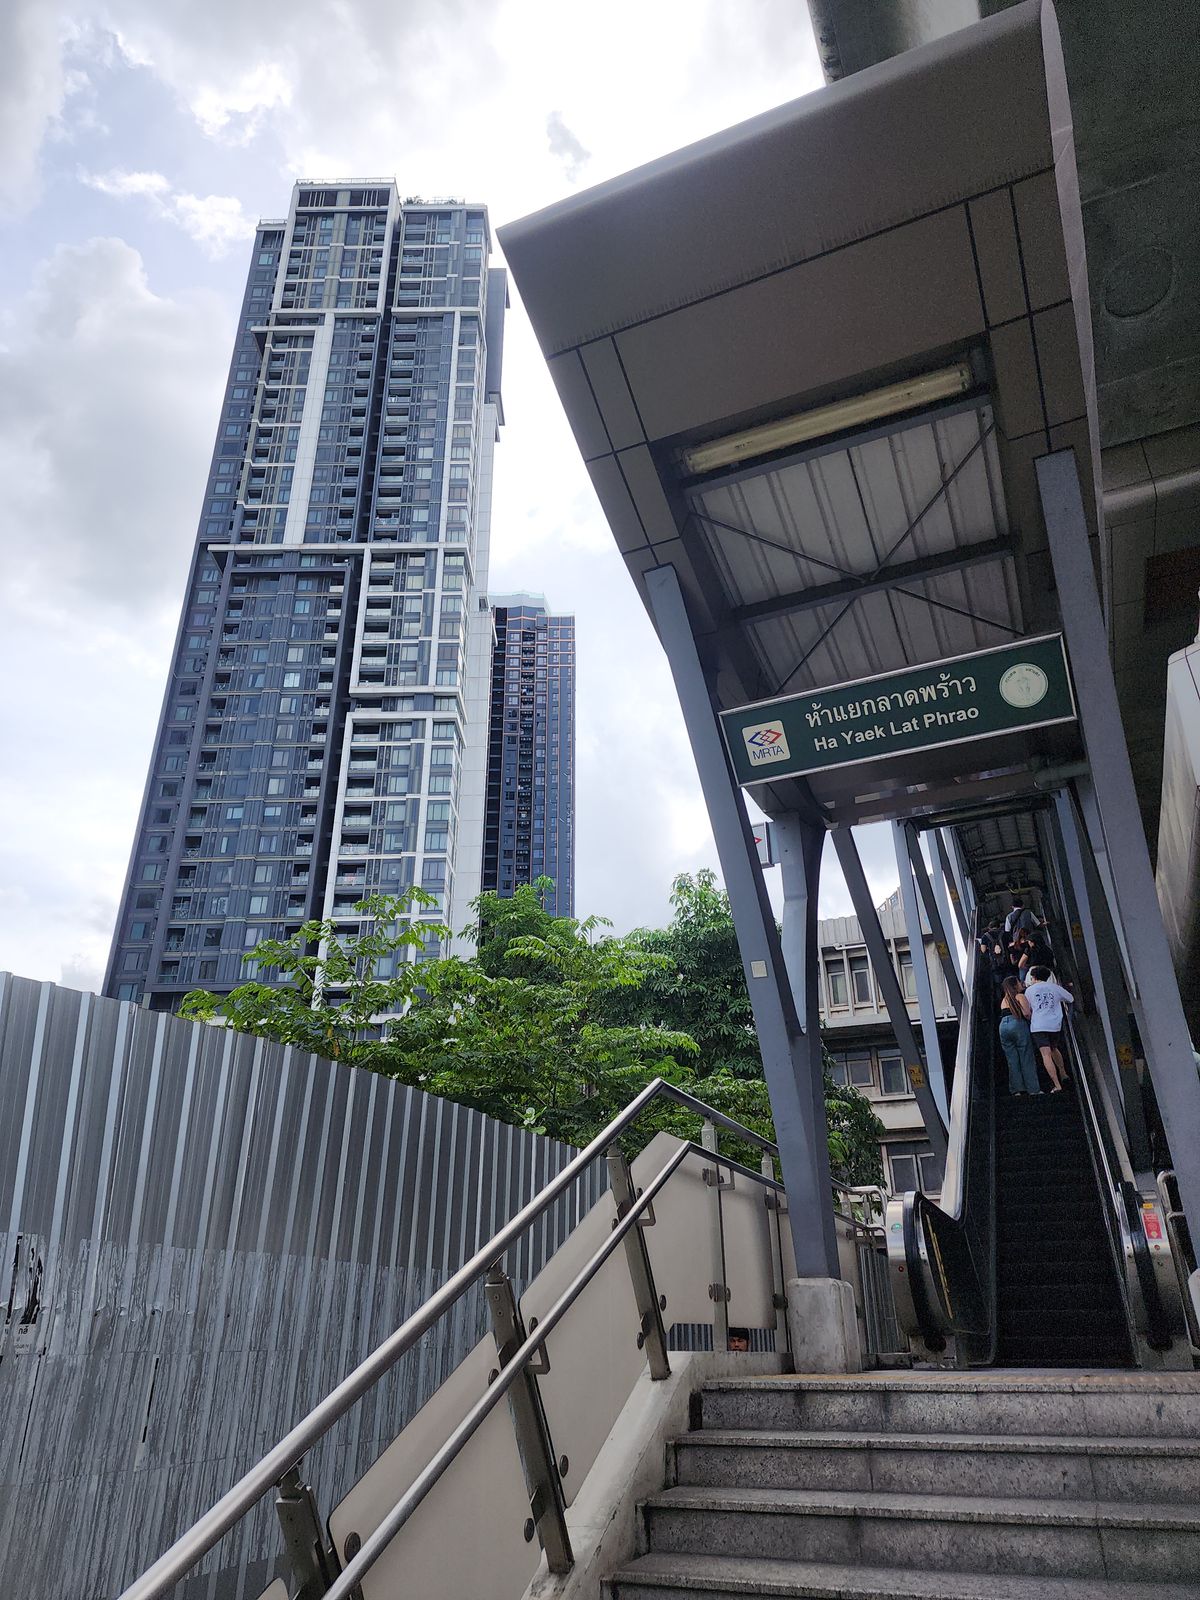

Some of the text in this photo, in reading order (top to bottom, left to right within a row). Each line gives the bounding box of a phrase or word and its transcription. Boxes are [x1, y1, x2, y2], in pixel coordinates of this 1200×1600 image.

[805, 673, 977, 728] ห้าแยกลาดพร้าว
[814, 706, 980, 751] Ha Yaek Lat Phrao
[752, 745, 784, 760] MRTA
